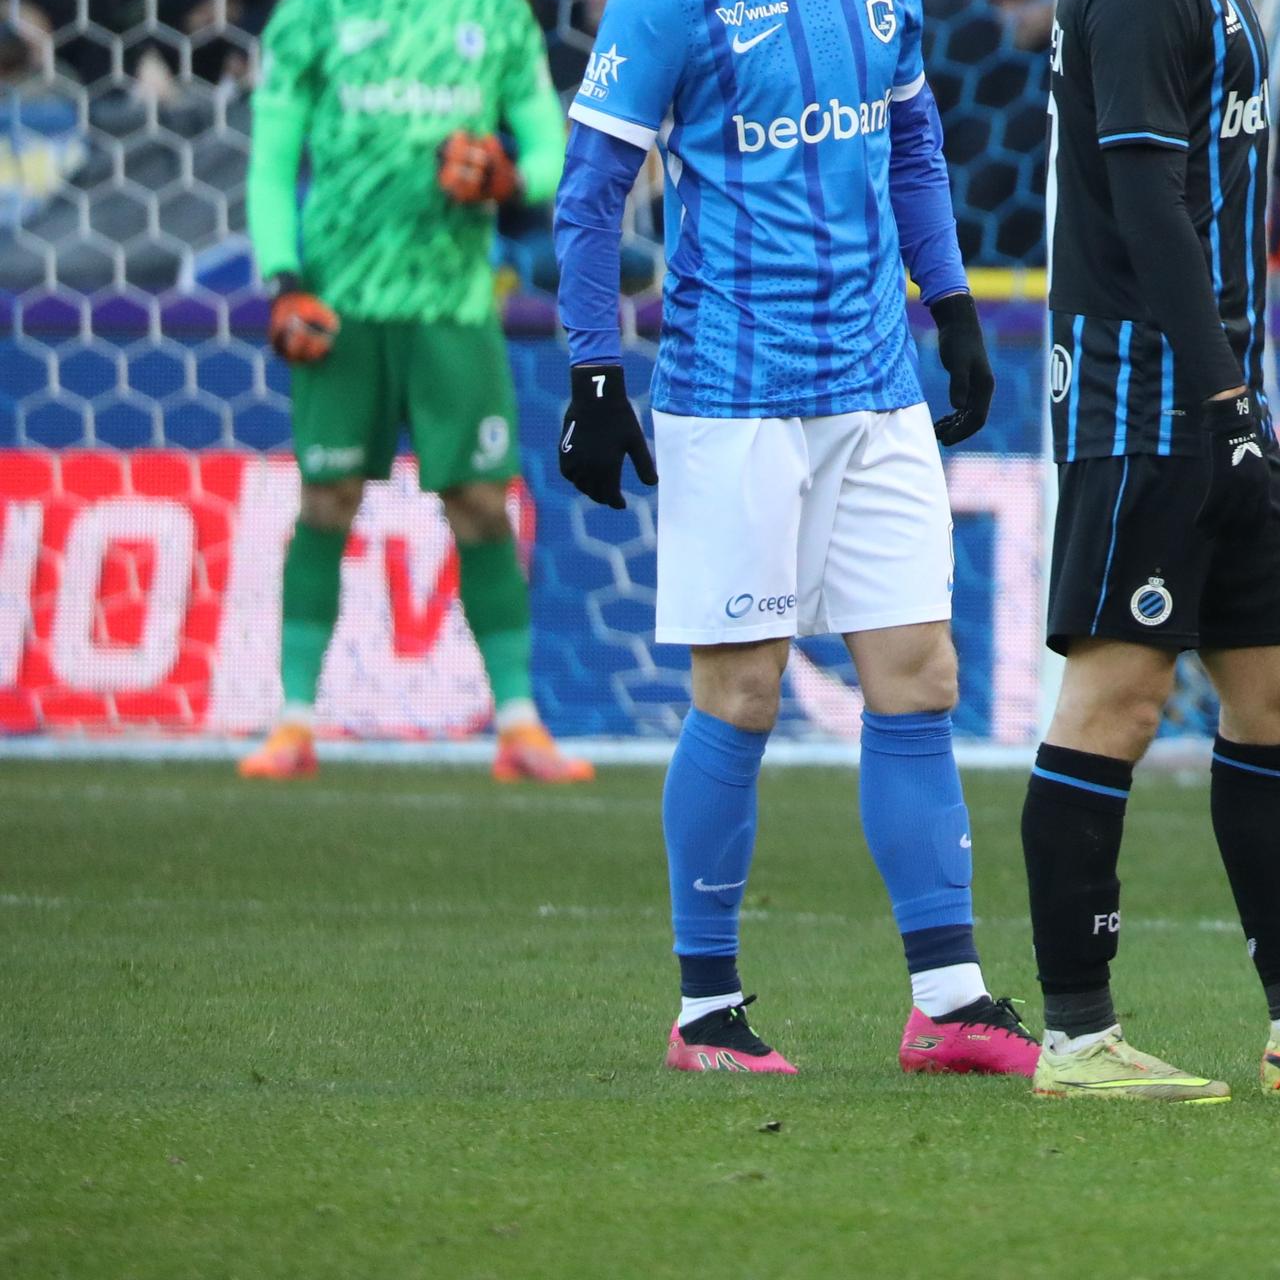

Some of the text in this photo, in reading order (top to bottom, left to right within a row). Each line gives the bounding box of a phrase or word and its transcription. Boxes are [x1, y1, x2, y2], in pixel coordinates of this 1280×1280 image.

[745, 1, 789, 21] WILMS
[592, 375, 606, 397] 7
[0, 496, 193, 692] O
